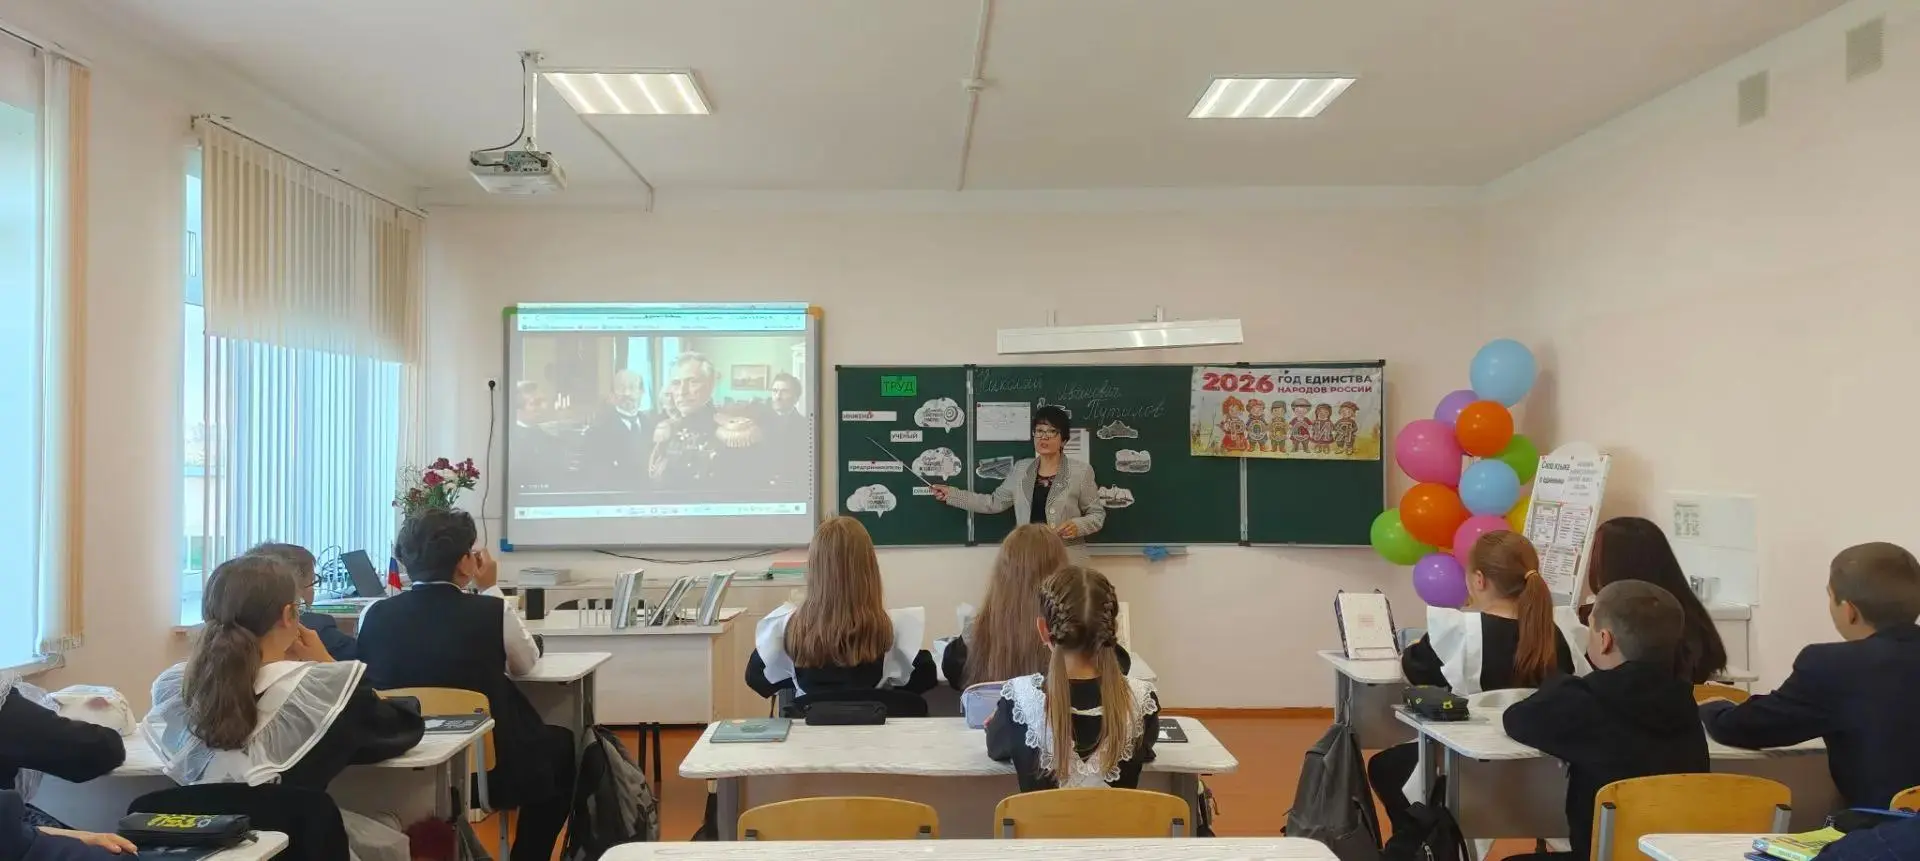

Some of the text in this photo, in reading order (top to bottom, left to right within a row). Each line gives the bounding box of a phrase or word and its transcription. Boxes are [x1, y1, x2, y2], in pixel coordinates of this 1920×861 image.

[884, 381, 914, 393] ТРУД
[1202, 372, 1372, 394] 2026 ГОД ЕДИНСТВА
[1277, 386, 1327, 394] НАРОДОВ
